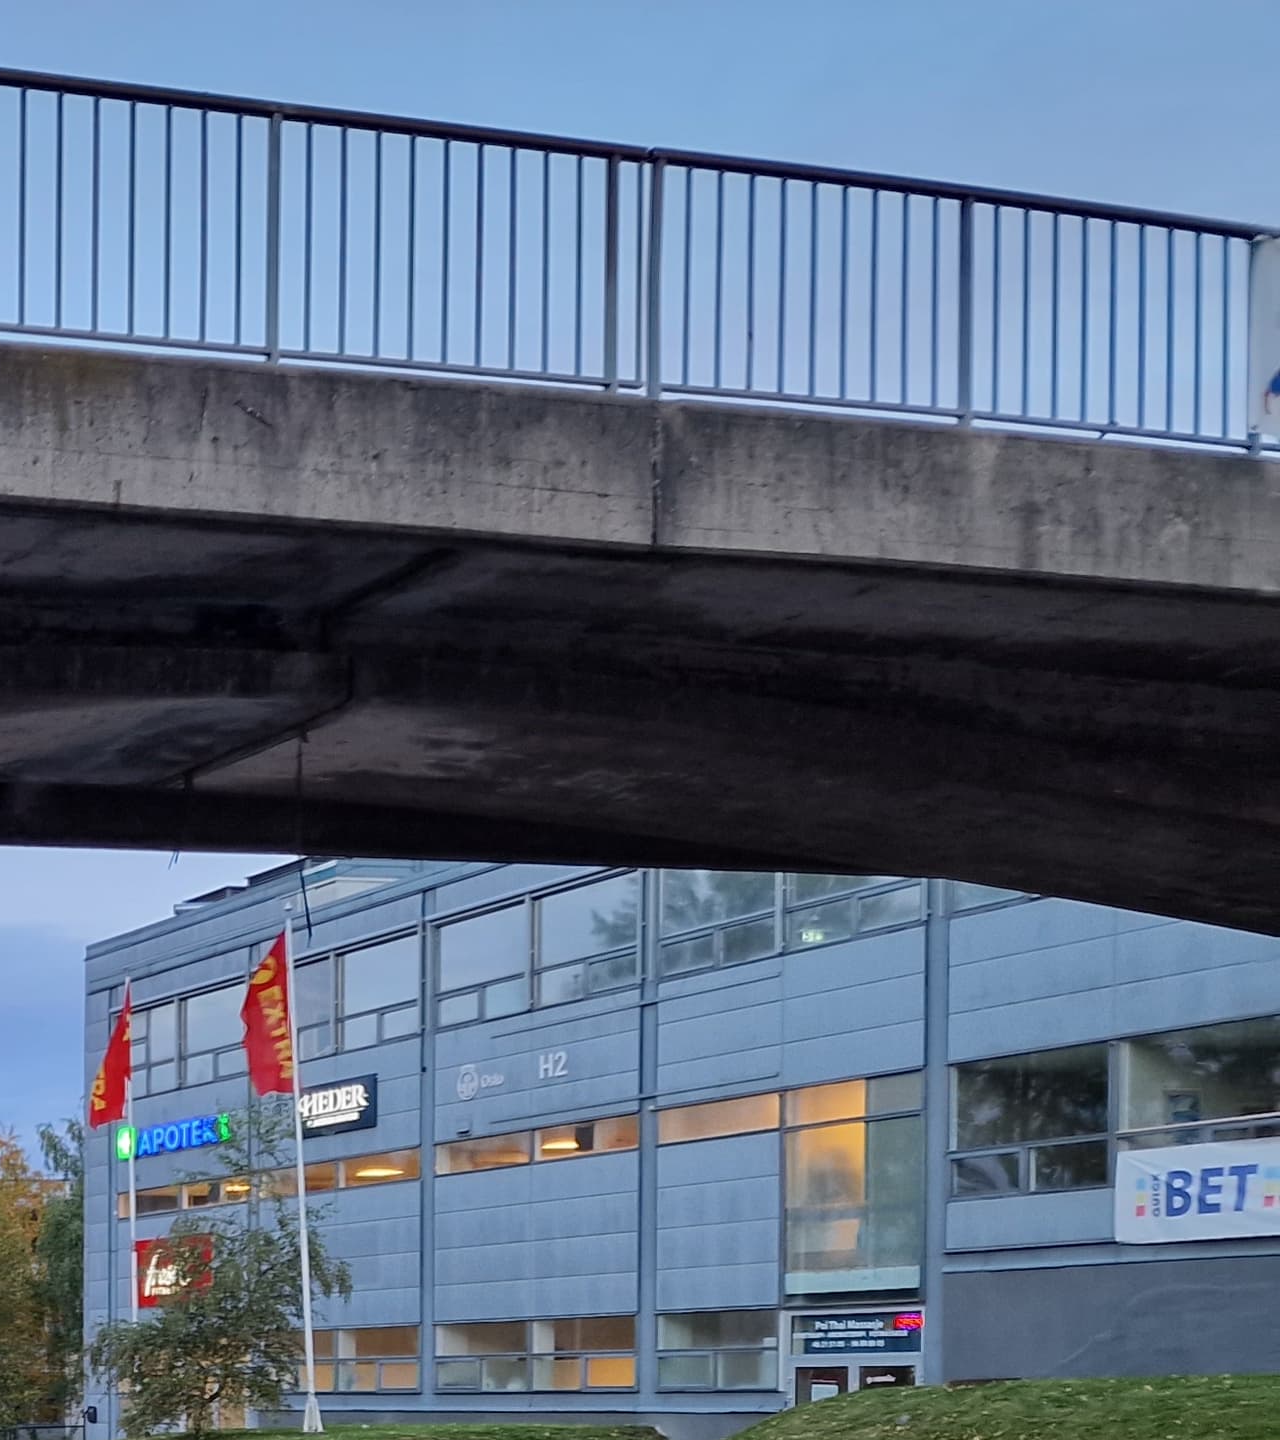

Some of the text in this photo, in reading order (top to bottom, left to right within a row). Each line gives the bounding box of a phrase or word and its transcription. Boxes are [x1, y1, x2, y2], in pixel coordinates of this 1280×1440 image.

[256, 985, 294, 1079] EXTRA
[539, 1051, 568, 1079] H2
[139, 1117, 218, 1155] APOTEK
[1165, 1164, 1259, 1217] BET
